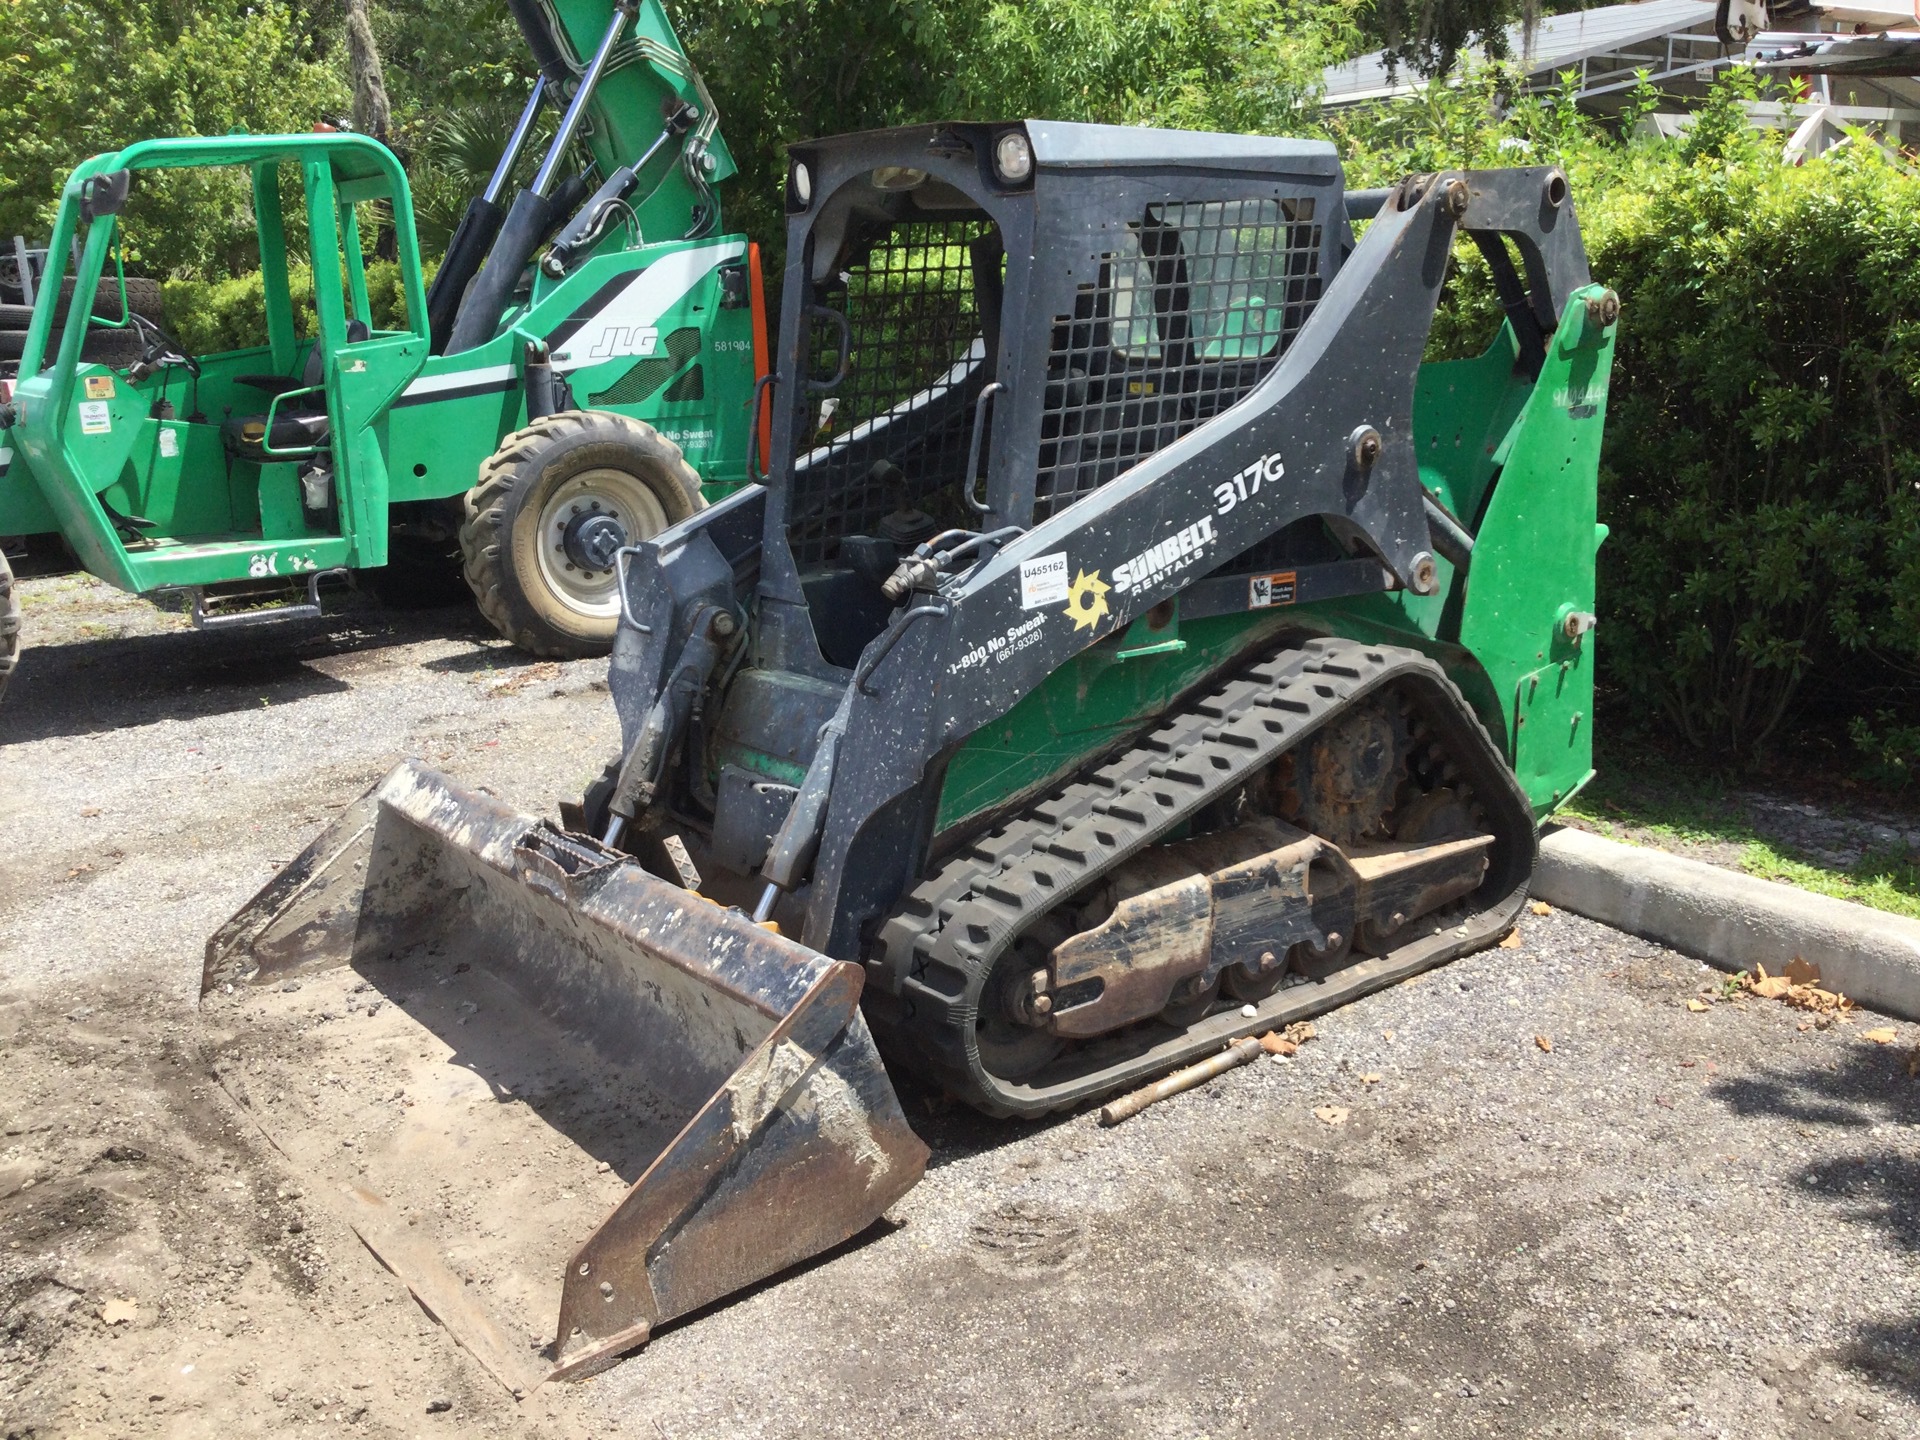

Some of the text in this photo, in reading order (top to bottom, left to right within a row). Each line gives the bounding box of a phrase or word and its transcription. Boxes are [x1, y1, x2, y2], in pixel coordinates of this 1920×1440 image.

[589, 326, 659, 358] JLG
[714, 340, 751, 352] 581904
[666, 430, 681, 441] No
[682, 429, 714, 440] Sweat
[1213, 452, 1285, 516] 317G
[1024, 561, 1064, 579] U455162
[1111, 514, 1214, 594] SUNBELT
[1131, 547, 1205, 597] RENTALS
[949, 611, 1046, 675] 1-800 No Sweat
[996, 628, 1043, 665] (667-9328)
